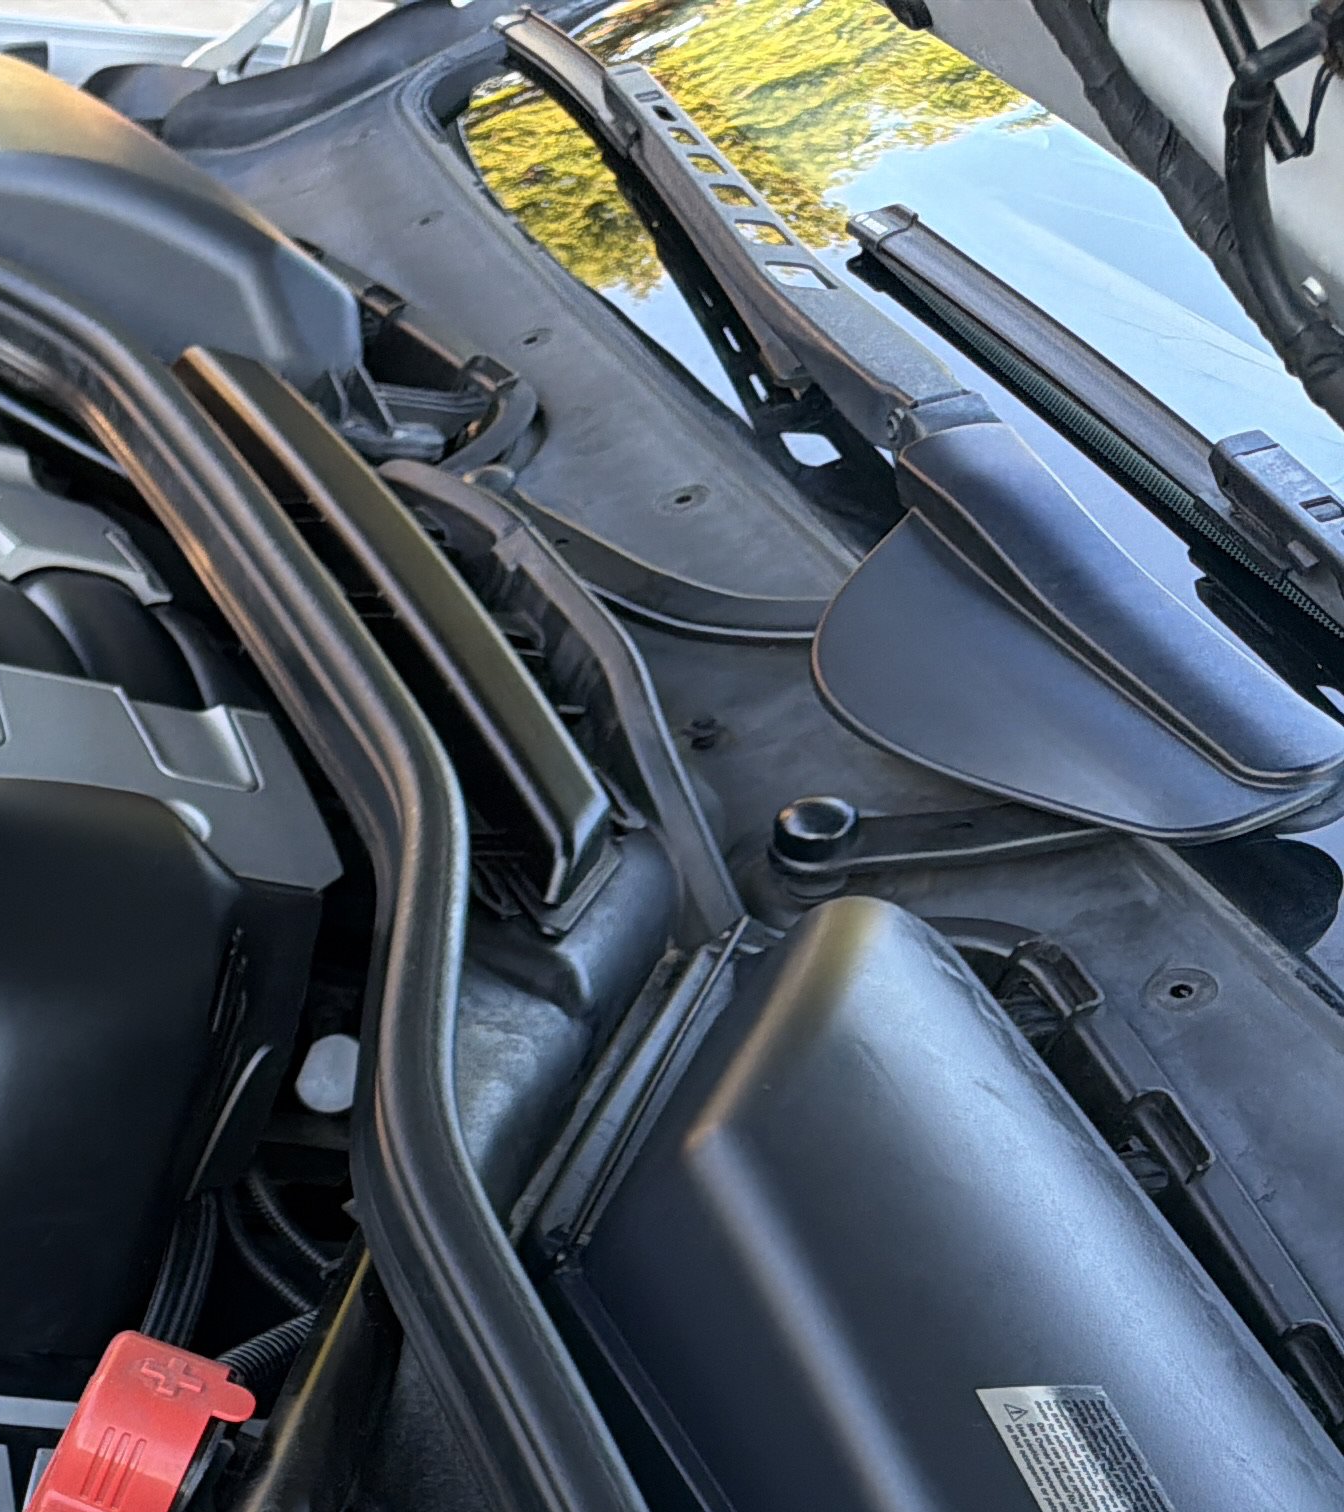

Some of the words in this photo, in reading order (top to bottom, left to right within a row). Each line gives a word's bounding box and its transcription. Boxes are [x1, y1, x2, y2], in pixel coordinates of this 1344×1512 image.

[1010, 1434, 1023, 1447] that
[1018, 1450, 1044, 1485] occupants
[1043, 1497, 1059, 1512] pets
[1015, 1423, 1028, 1436] Use
[1023, 1439, 1043, 1464] caution
[1038, 1466, 1063, 1499] whenever
[1027, 1423, 1039, 1435] See
[1035, 1437, 1056, 1465] Owner's
[1051, 1468, 1071, 1492] Manual
[1066, 1494, 1077, 1503] for
[1037, 1422, 1047, 1431] Do
[1043, 1434, 1055, 1444] not
[1050, 1447, 1062, 1458] use
[1057, 1461, 1071, 1473] key
